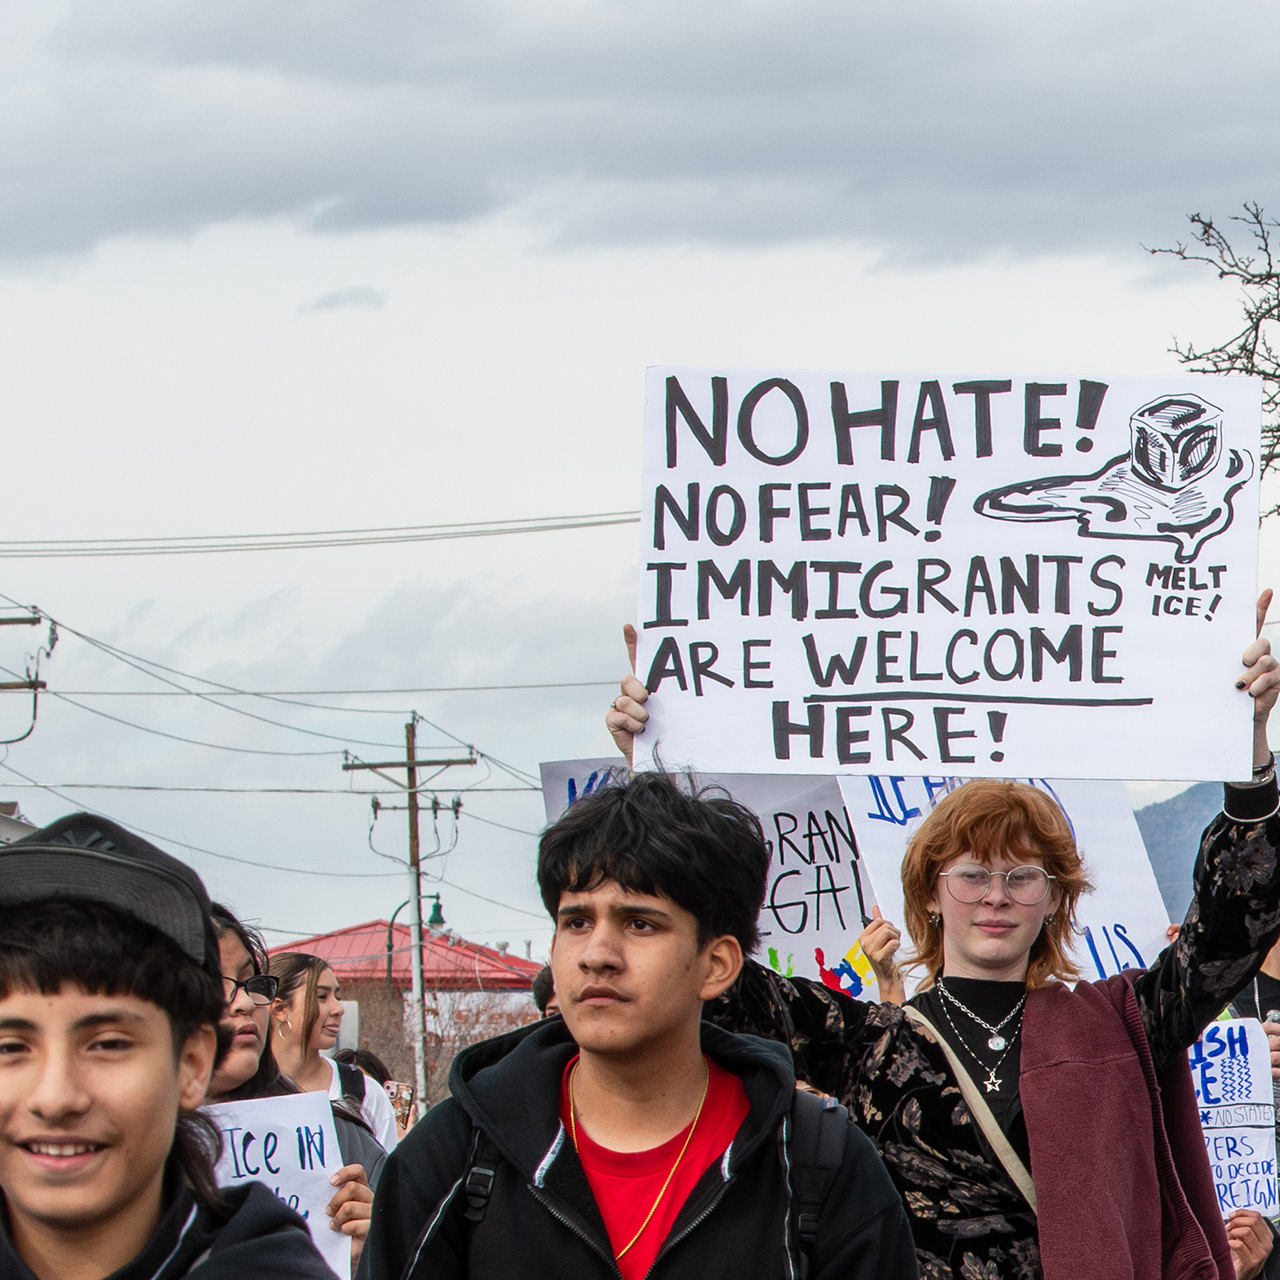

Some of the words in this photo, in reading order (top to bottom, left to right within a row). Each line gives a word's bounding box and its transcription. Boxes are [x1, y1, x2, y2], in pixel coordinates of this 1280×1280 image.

[665, 376, 809, 469] NO
[830, 379, 1108, 466] HATE!
[758, 476, 957, 543] FEAR!
[643, 554, 1126, 630] IMMIGRANTS
[1145, 562, 1227, 591] MELT
[1151, 594, 1222, 622] ICE!
[644, 636, 774, 697] ARE
[801, 624, 1124, 688] WELCOME
[772, 700, 1008, 765] HERE!
[1228, 1158, 1275, 1180] DECIDE
